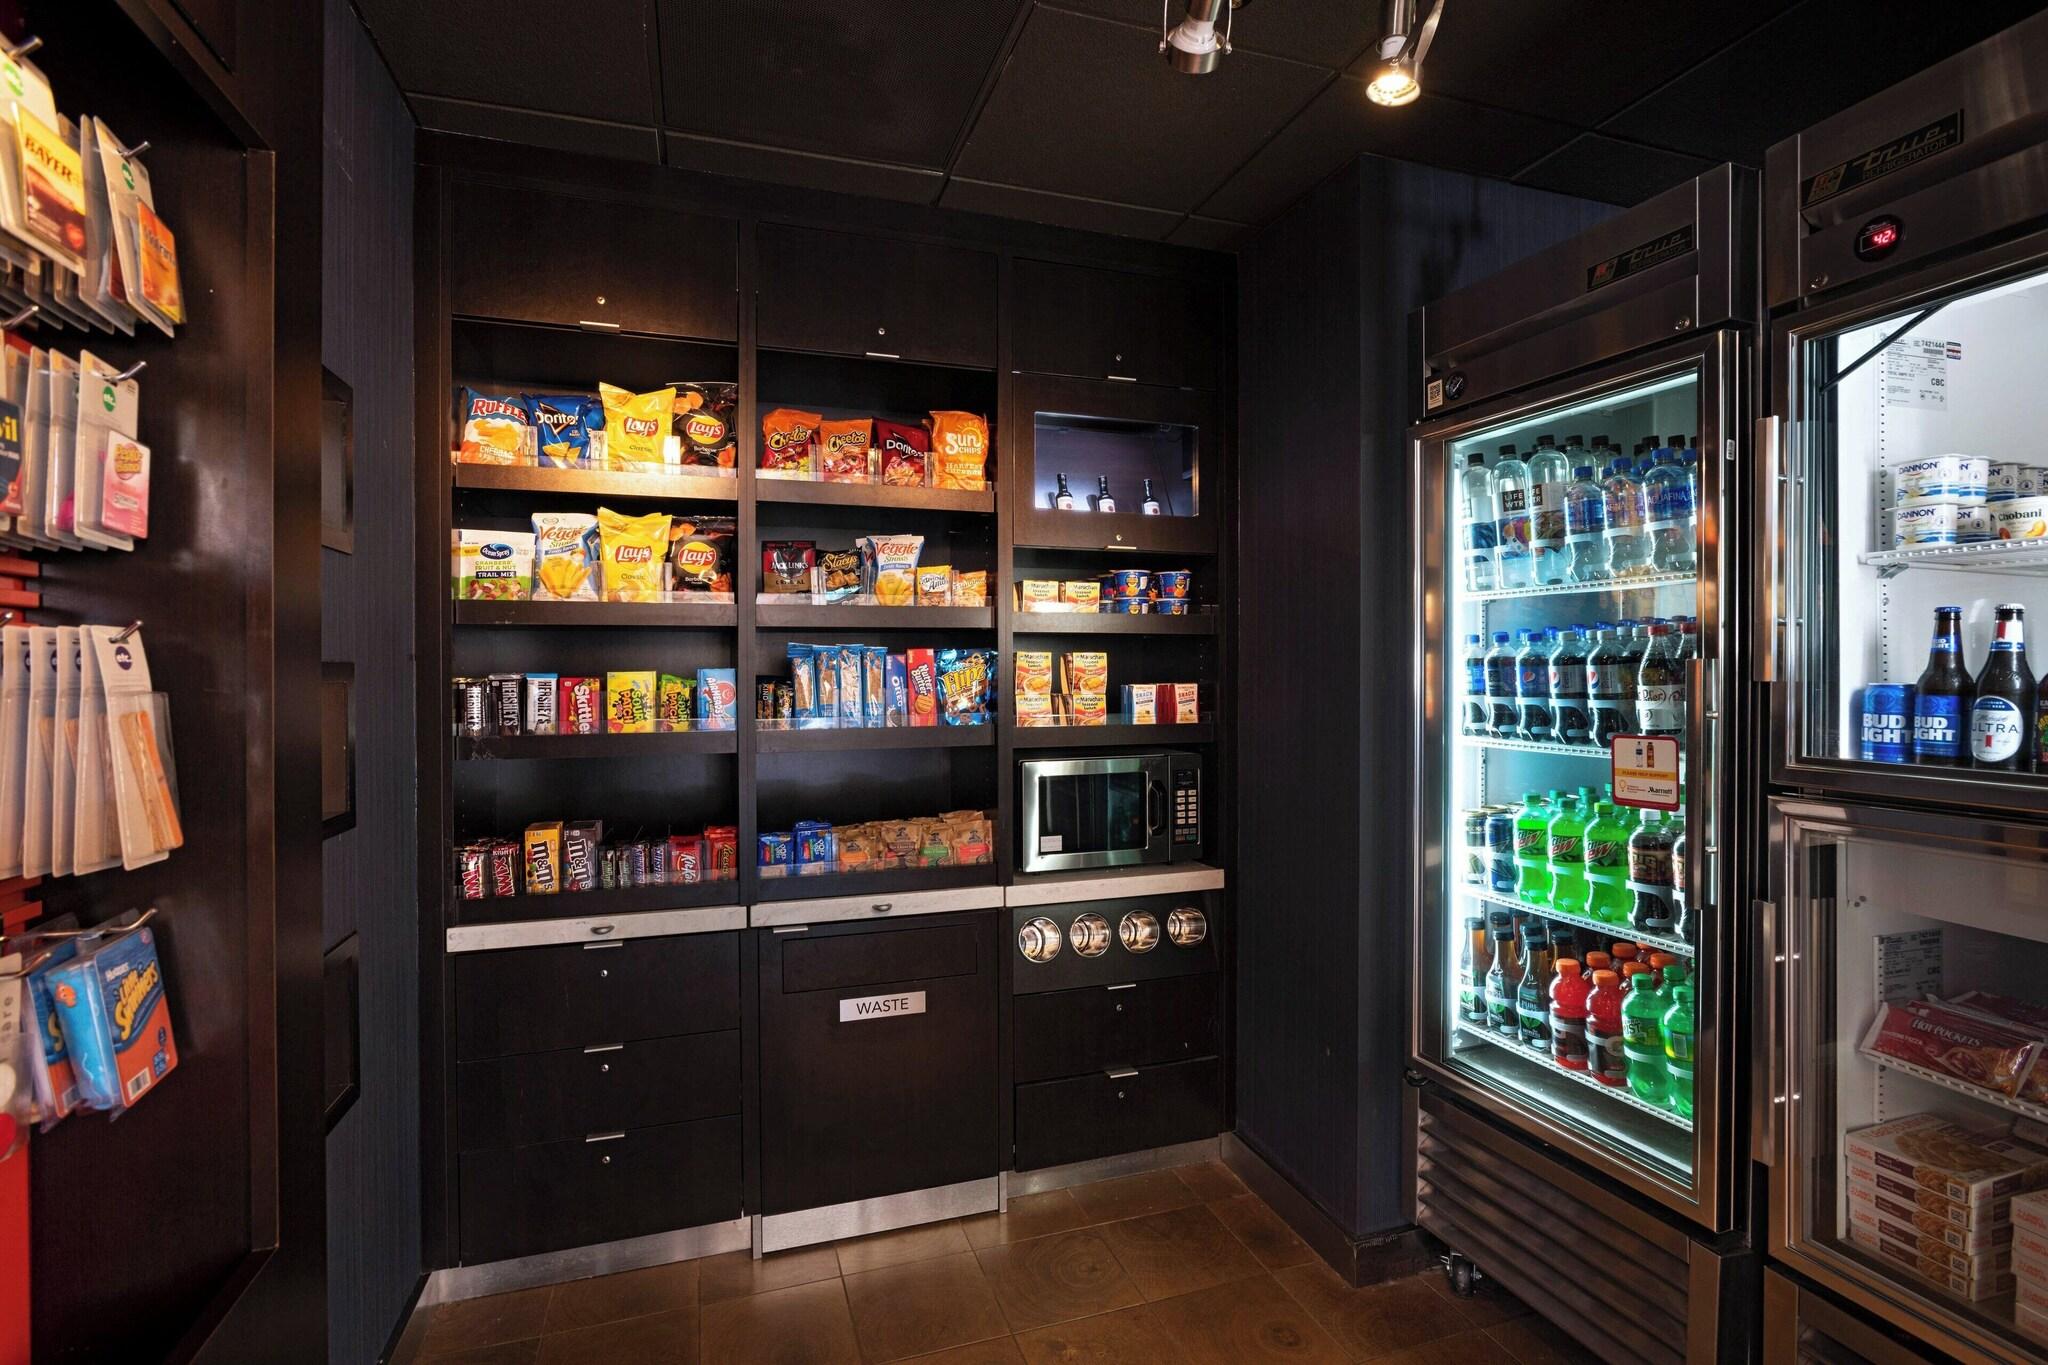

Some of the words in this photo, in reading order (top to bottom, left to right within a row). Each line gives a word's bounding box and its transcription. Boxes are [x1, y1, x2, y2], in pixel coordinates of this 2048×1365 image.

[24, 136, 73, 181] BAYER
[1931, 378, 1944, 386] CBC
[471, 399, 528, 424] RUFFLE
[625, 417, 658, 437] Lay's
[690, 422, 722, 438] Lay's
[828, 431, 867, 453] Cheetos
[886, 439, 925, 458] Doritos
[945, 432, 981, 455] Sun
[1898, 461, 1940, 475] DANNON
[1504, 492, 1524, 501] LIFE
[1897, 508, 1936, 521] DANNON
[1998, 508, 2043, 522] Chobani
[482, 548, 497, 557] Ocean
[496, 549, 511, 559] Spray
[617, 546, 653, 564] Lay's
[681, 549, 715, 566] Lay's
[876, 542, 919, 556] Veggie
[911, 668, 928, 696] Butter
[918, 664, 933, 692] Nutter
[943, 663, 986, 697] Flipz
[538, 681, 552, 725] HERSHEY'S
[620, 689, 635, 724] PATCH
[631, 690, 645, 721] SOUR
[668, 691, 679, 724] PATCH
[677, 694, 688, 722] SOUR
[1863, 713, 1907, 729] BUD
[1914, 716, 1948, 729] BUD
[1971, 723, 2019, 734] ULTRA
[1648, 786, 1672, 795] Marriott
[856, 997, 909, 1016] WASTE
[1912, 1019, 1933, 1034] HOT
